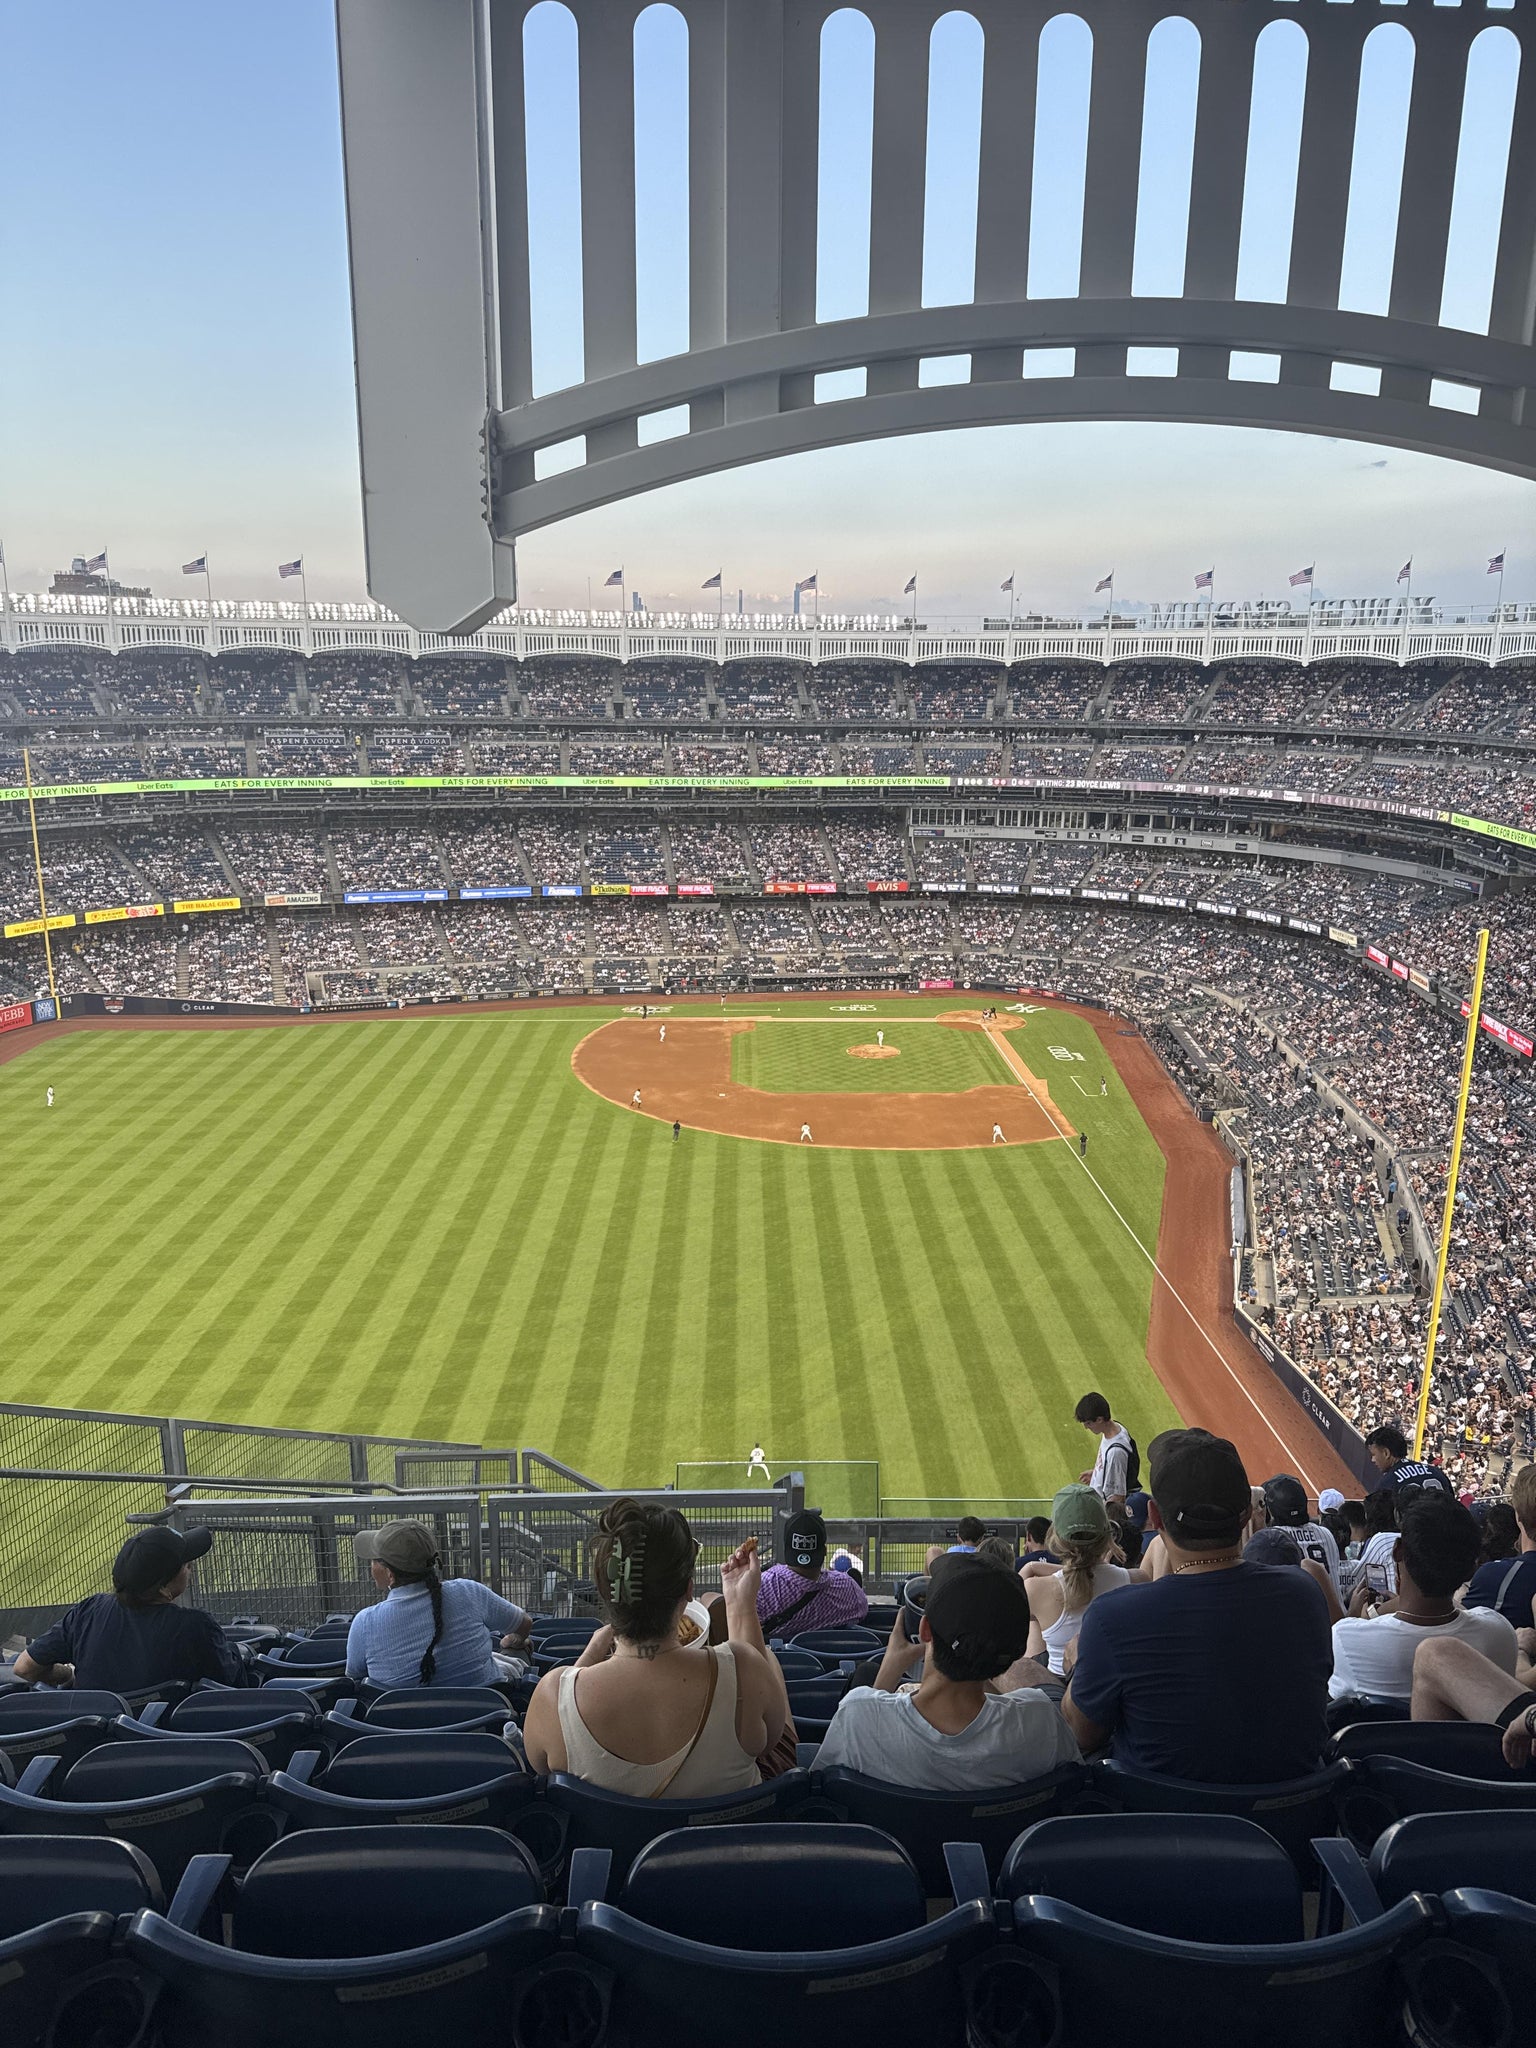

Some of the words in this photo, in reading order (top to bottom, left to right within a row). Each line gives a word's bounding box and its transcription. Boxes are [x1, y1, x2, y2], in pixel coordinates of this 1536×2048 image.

[214, 780, 238, 788] EATS
[242, 780, 261, 788] FOR
[4, 790, 25, 798] FOR
[61, 785, 97, 794] INNING
[1487, 824, 1499, 835] EATS
[1500, 828, 1511, 838] FOR
[1511, 830, 1528, 843] EVERY
[876, 883, 898, 891] AVIS
[1312, 1403, 1331, 1430] CLEAR
[1394, 1464, 1432, 1483] JUDGE
[1290, 1530, 1316, 1542] UDGE
